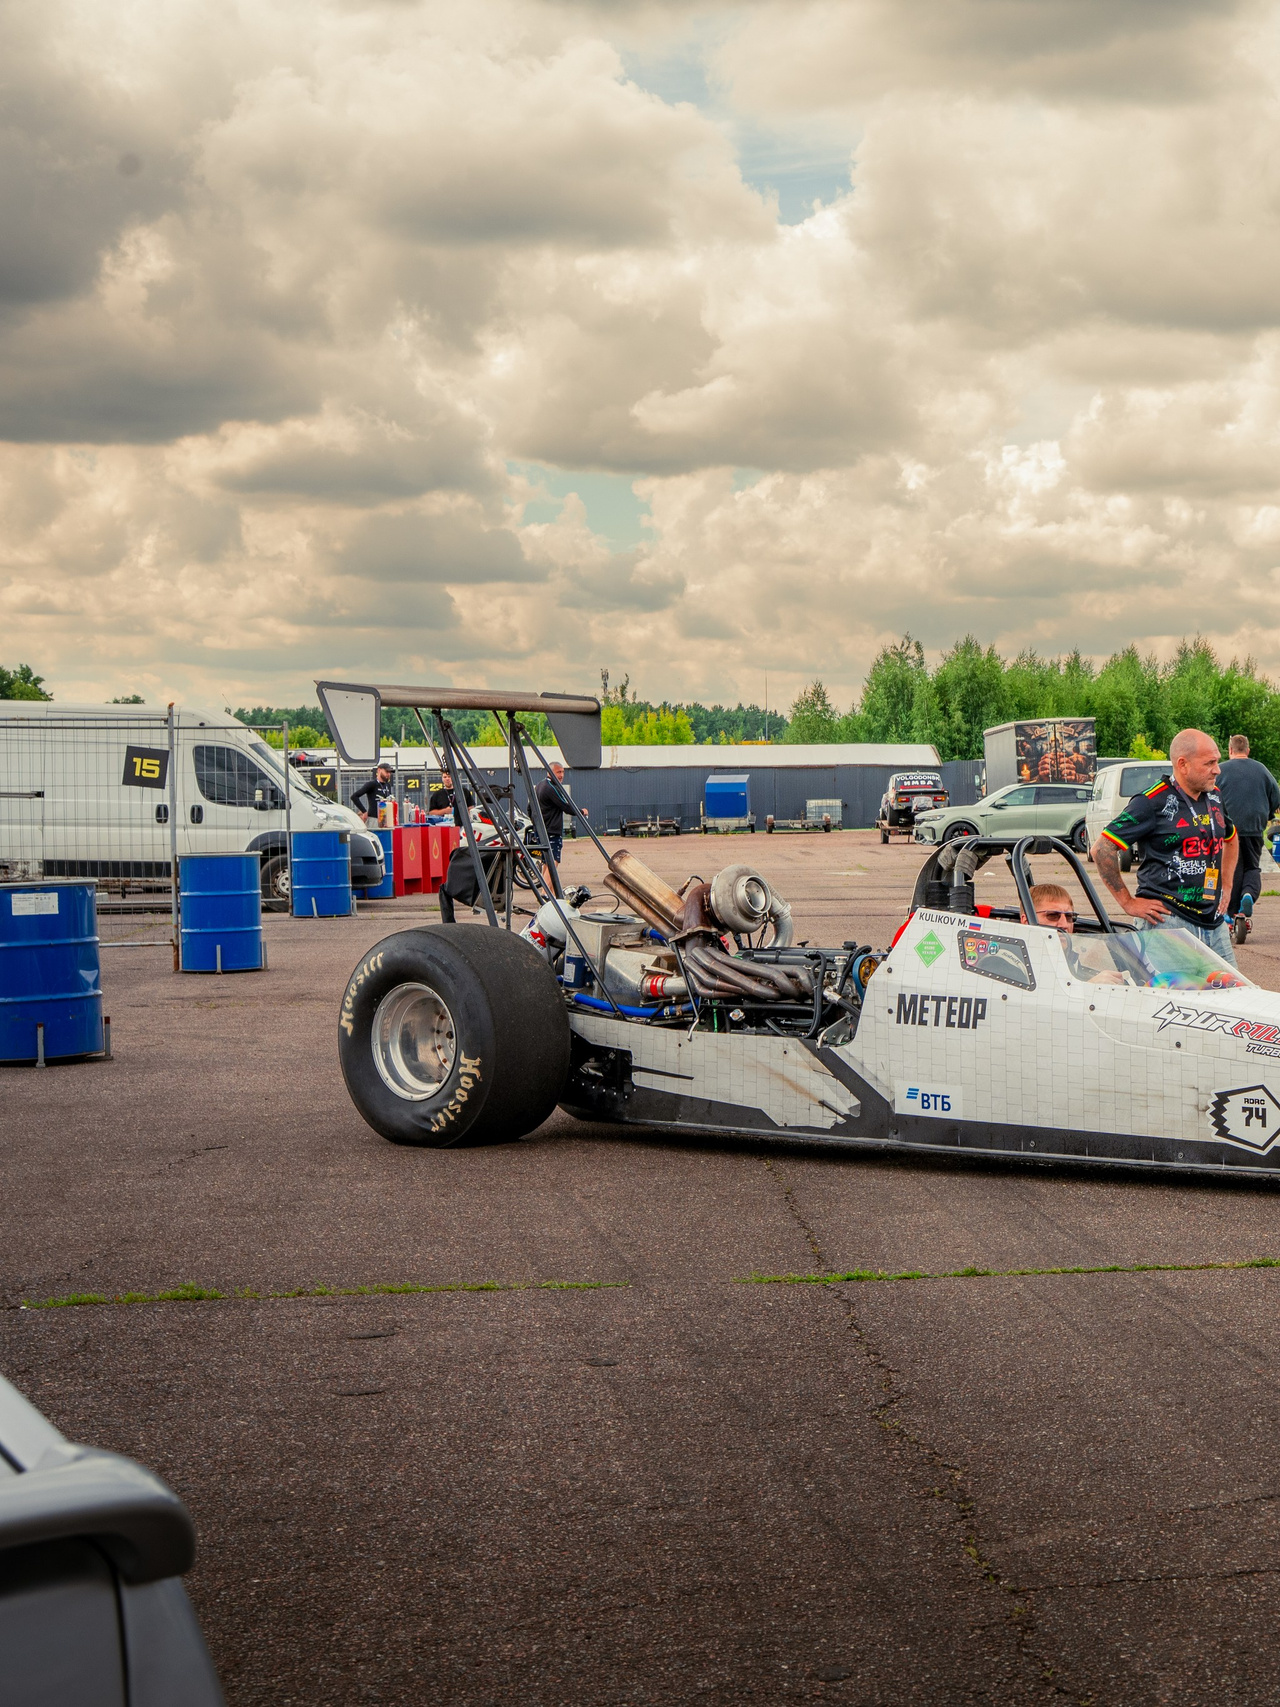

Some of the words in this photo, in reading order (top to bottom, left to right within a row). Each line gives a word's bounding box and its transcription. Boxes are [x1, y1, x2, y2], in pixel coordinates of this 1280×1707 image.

[132, 757, 160, 779] 15
[315, 774, 331, 787] 17
[407, 779, 419, 789] 21
[919, 912, 956, 926] KULIKOV
[957, 918, 968, 928] M.
[340, 952, 384, 1037] Hoosier
[896, 994, 987, 1029] МЕТЕОР
[427, 1050, 483, 1133] Hoosier
[921, 1093, 951, 1111] ВТБ
[1241, 1106, 1267, 1128] 74
